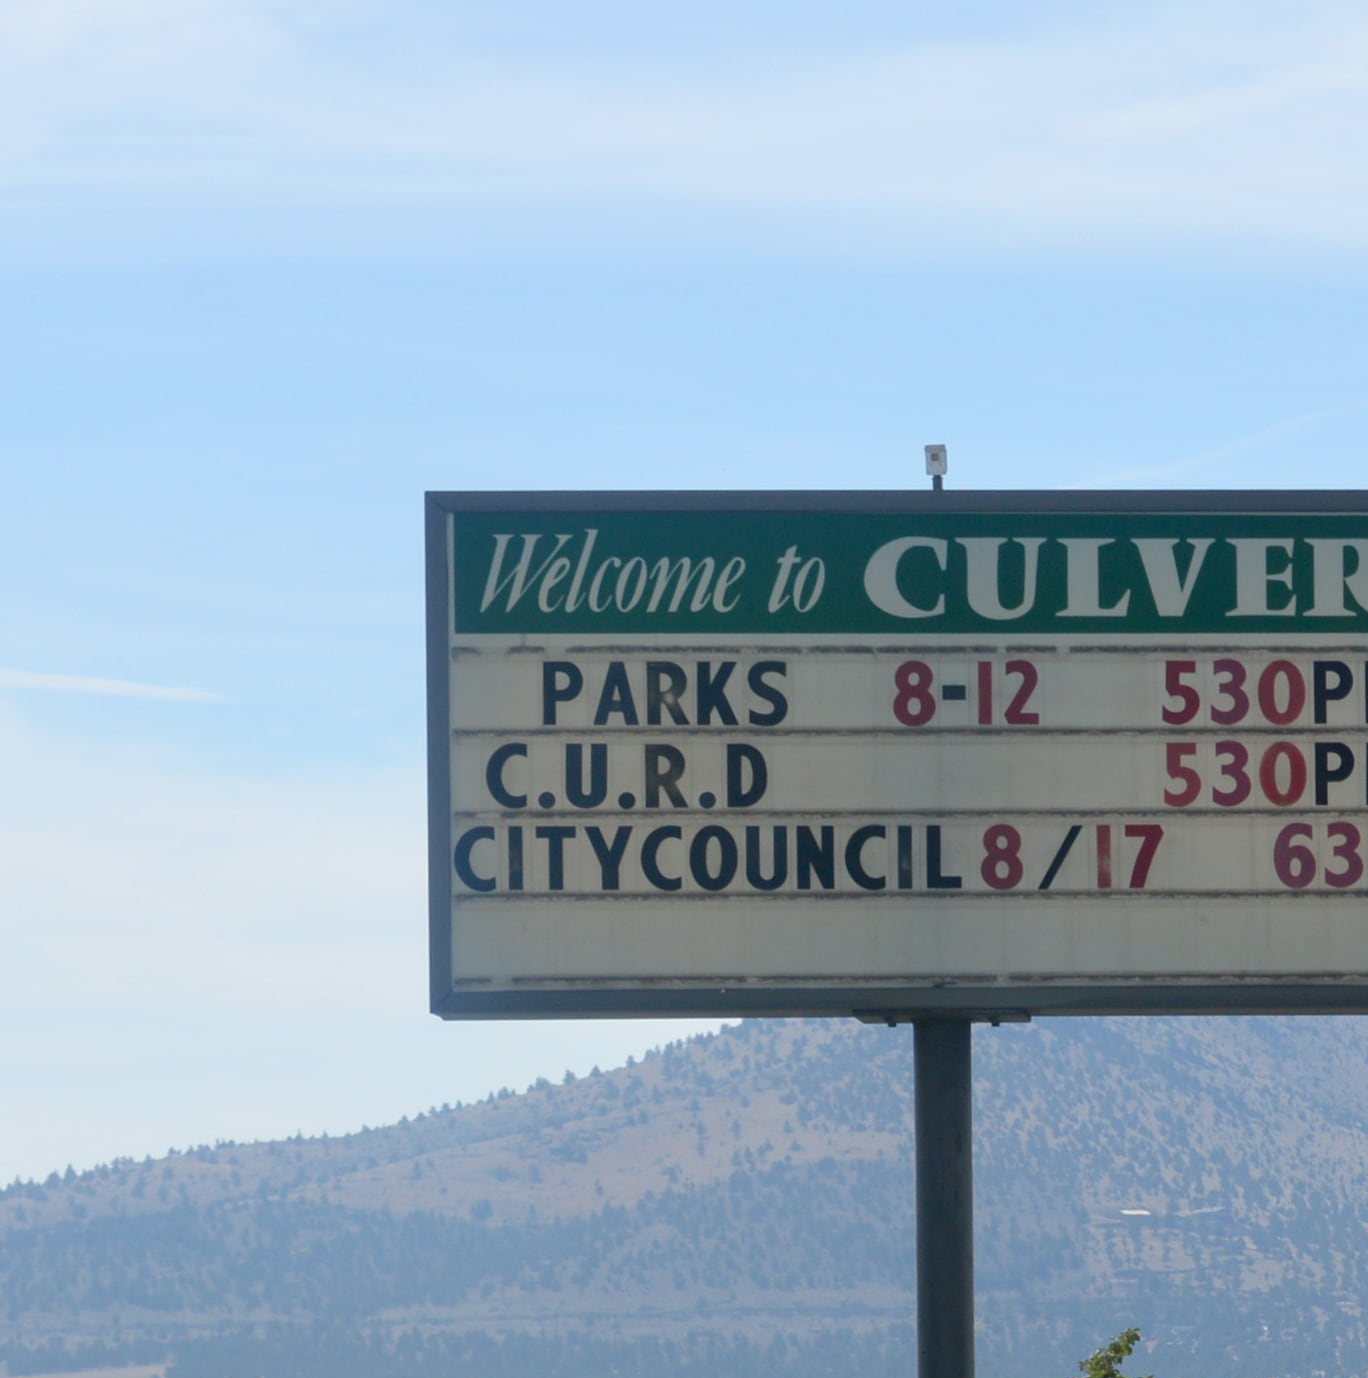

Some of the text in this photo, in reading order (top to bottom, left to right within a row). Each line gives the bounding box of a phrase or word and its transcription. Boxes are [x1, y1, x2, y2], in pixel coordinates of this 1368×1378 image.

[480, 529, 745, 613] Welcome
[768, 544, 826, 613] to
[542, 661, 788, 726] PARKS
[892, 660, 1040, 726] 8-12
[486, 743, 769, 809] C.U.R.D
